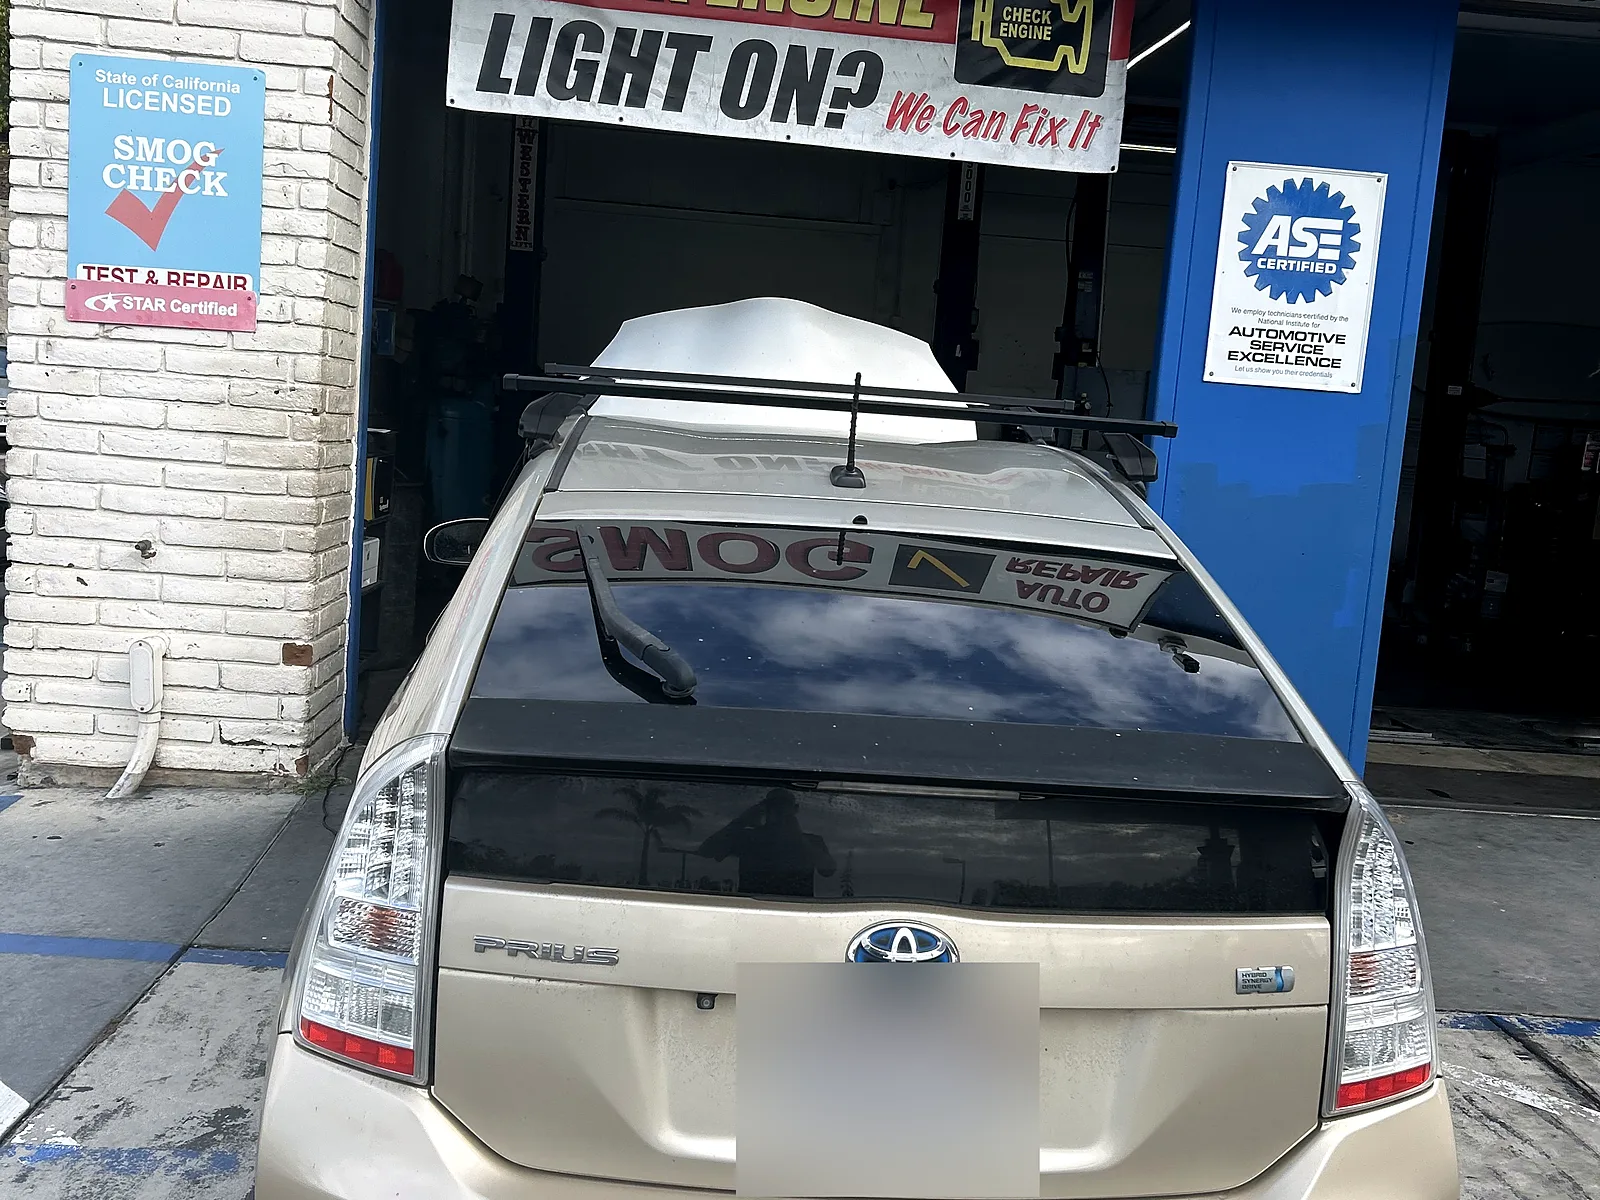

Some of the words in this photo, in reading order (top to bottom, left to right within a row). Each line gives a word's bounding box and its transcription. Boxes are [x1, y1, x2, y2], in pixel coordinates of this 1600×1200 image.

[1002, 6, 1052, 24] CHECK
[999, 22, 1052, 41] ENGINE
[95, 69, 138, 86] State
[141, 74, 159, 87] of
[162, 75, 241, 95] California
[475, 12, 714, 113] LIGHT
[719, 38, 884, 130] ON?
[103, 87, 232, 117] LICENSED
[885, 90, 936, 134] We
[942, 95, 1008, 141] Can
[1009, 102, 1068, 149] Fix
[1067, 109, 1104, 150] It
[113, 135, 219, 168] SMOG
[102, 163, 228, 197] CHECK
[1251, 214, 1344, 261] ASE
[1256, 257, 1337, 275] CERTIFIED
[82, 265, 138, 283] TEST
[145, 270, 159, 285] &
[167, 271, 248, 291] REPAIR
[122, 295, 167, 313] STAR
[170, 299, 238, 317] Certified
[1231, 306, 1242, 314] We
[1243, 308, 1267, 317] employ
[1267, 309, 1302, 318] technicians
[1303, 313, 1329, 321] certified
[1329, 314, 1338, 323] by
[1257, 317, 1284, 326] National
[1285, 319, 1310, 328] Institute
[1311, 321, 1321, 329] for
[1228, 326, 1346, 345] AUTOMOTIVE
[1250, 340, 1325, 356] SERVICE
[1227, 350, 1342, 369] EXCELLENCE
[1254, 366, 1271, 374] show
[1272, 368, 1284, 376] you
[1298, 370, 1333, 379] credentials
[473, 934, 620, 966] PRIUS
